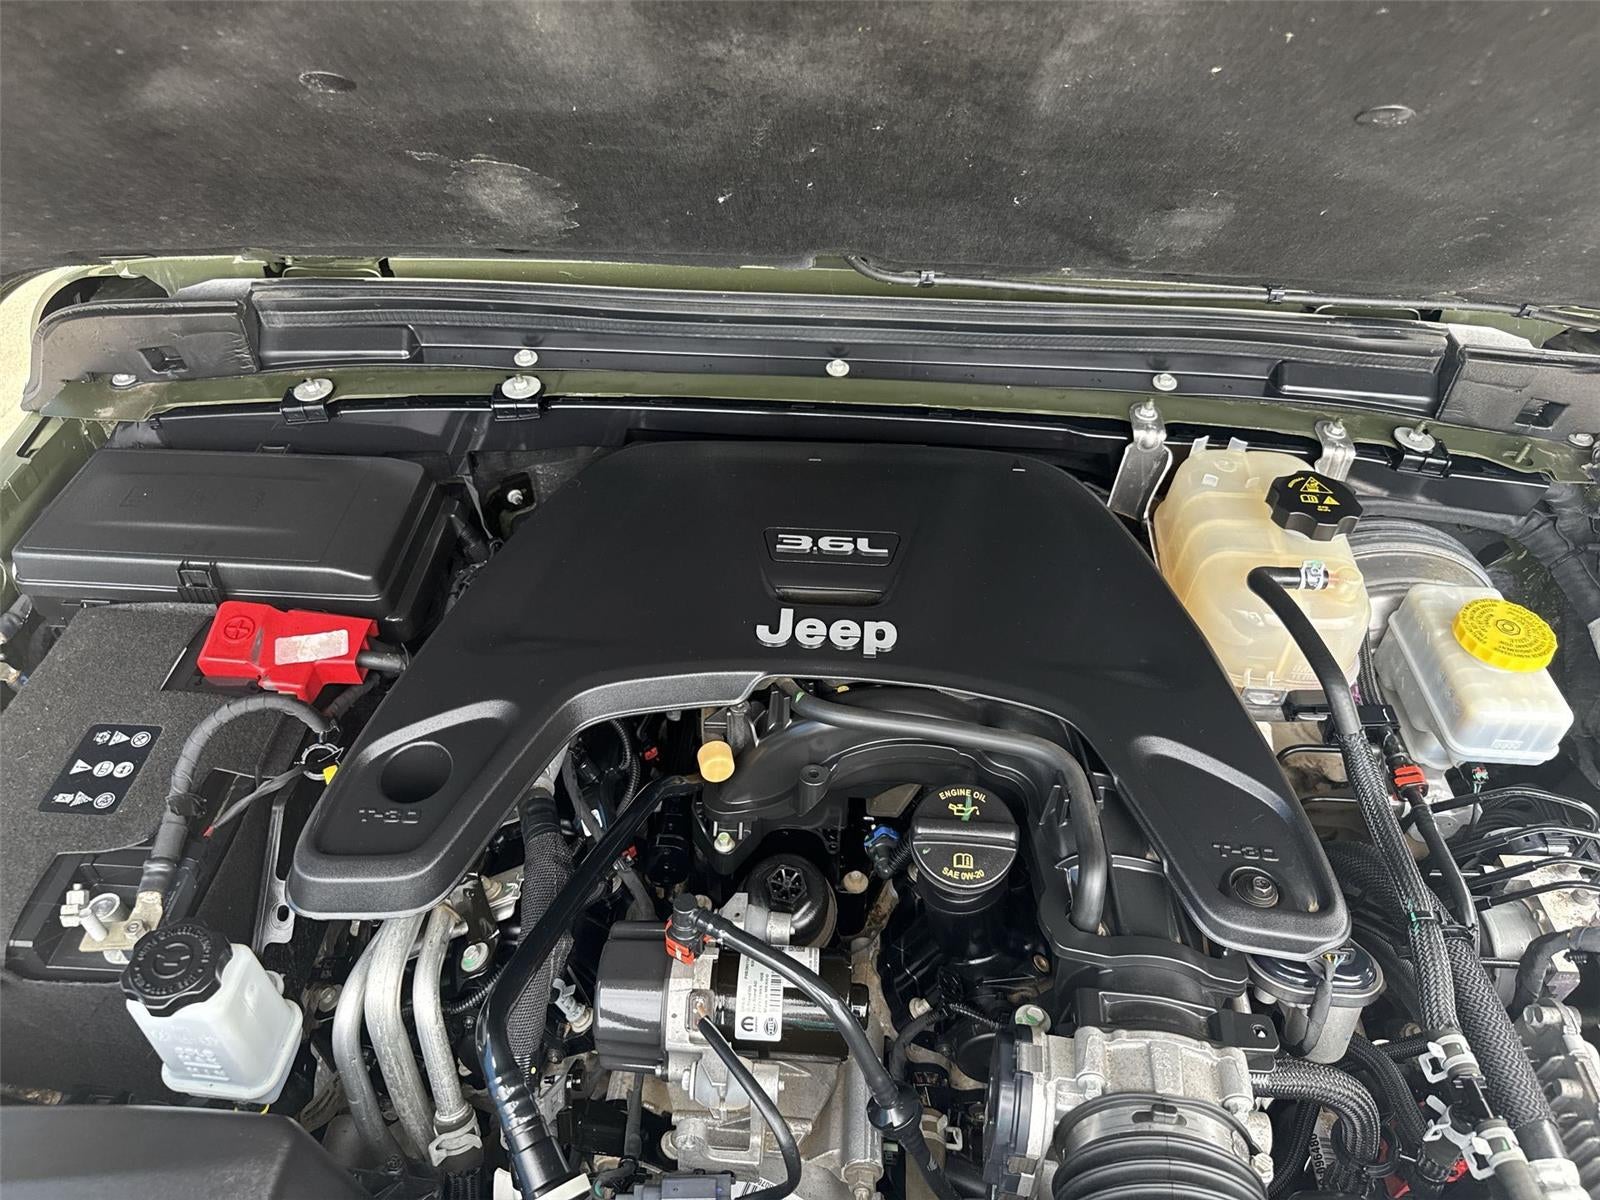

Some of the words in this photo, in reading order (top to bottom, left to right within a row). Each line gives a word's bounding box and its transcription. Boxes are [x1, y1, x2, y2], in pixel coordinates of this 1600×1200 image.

[775, 534, 889, 557] 3.6L
[755, 607, 898, 659] Jeep
[938, 788, 972, 801] ENGINE
[973, 791, 988, 804] OIL
[941, 867, 961, 881] SAE
[961, 869, 986, 881] 0W-20
